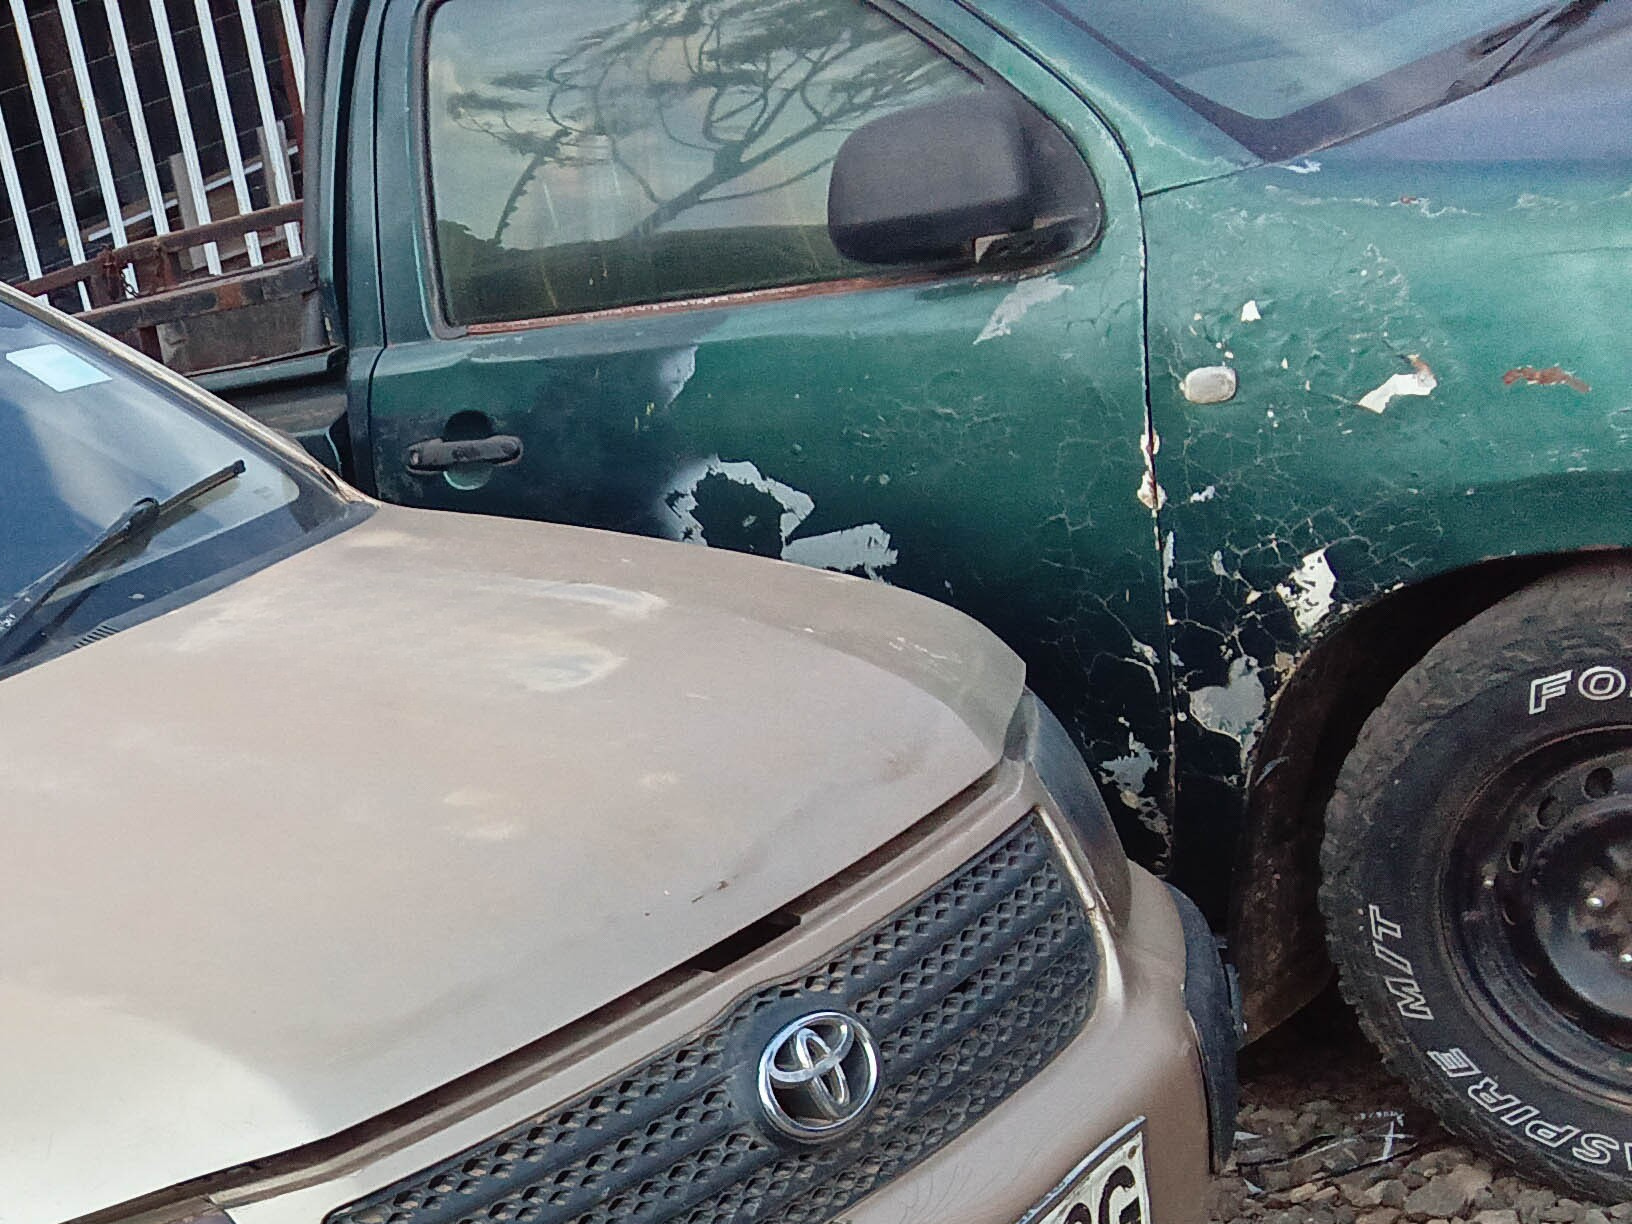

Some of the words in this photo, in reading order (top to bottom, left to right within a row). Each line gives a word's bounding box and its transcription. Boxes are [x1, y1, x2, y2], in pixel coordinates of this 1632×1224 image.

[1529, 665, 1632, 715] FO
[1368, 903, 1435, 1021] M/T
[1426, 1047, 1632, 1171] SPIRE
